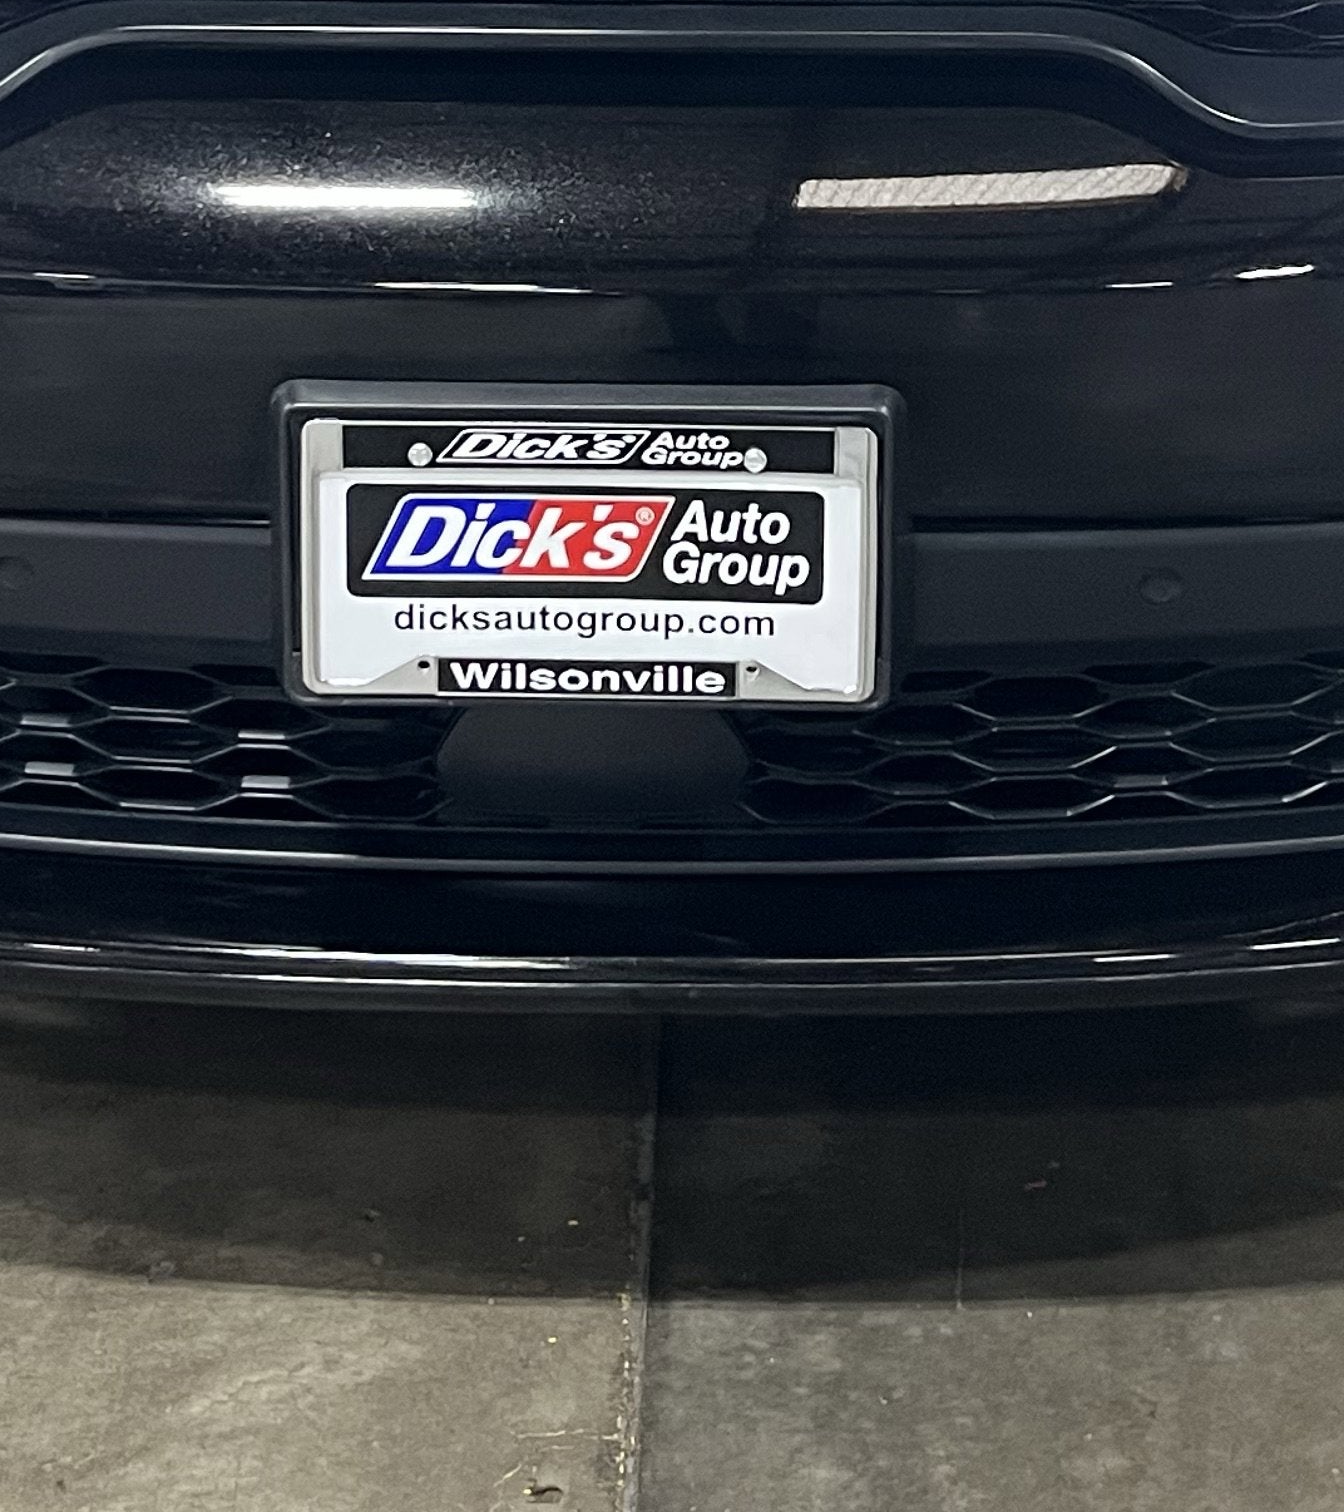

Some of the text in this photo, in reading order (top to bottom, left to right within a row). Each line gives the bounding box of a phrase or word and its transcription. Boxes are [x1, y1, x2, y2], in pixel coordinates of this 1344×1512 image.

[652, 431, 730, 450] Auto
[641, 447, 744, 469] Group
[670, 500, 791, 545] Auto
[663, 542, 811, 596] Group
[394, 603, 775, 640] dicksautogroup.com
[449, 662, 726, 694] Wilsonville
